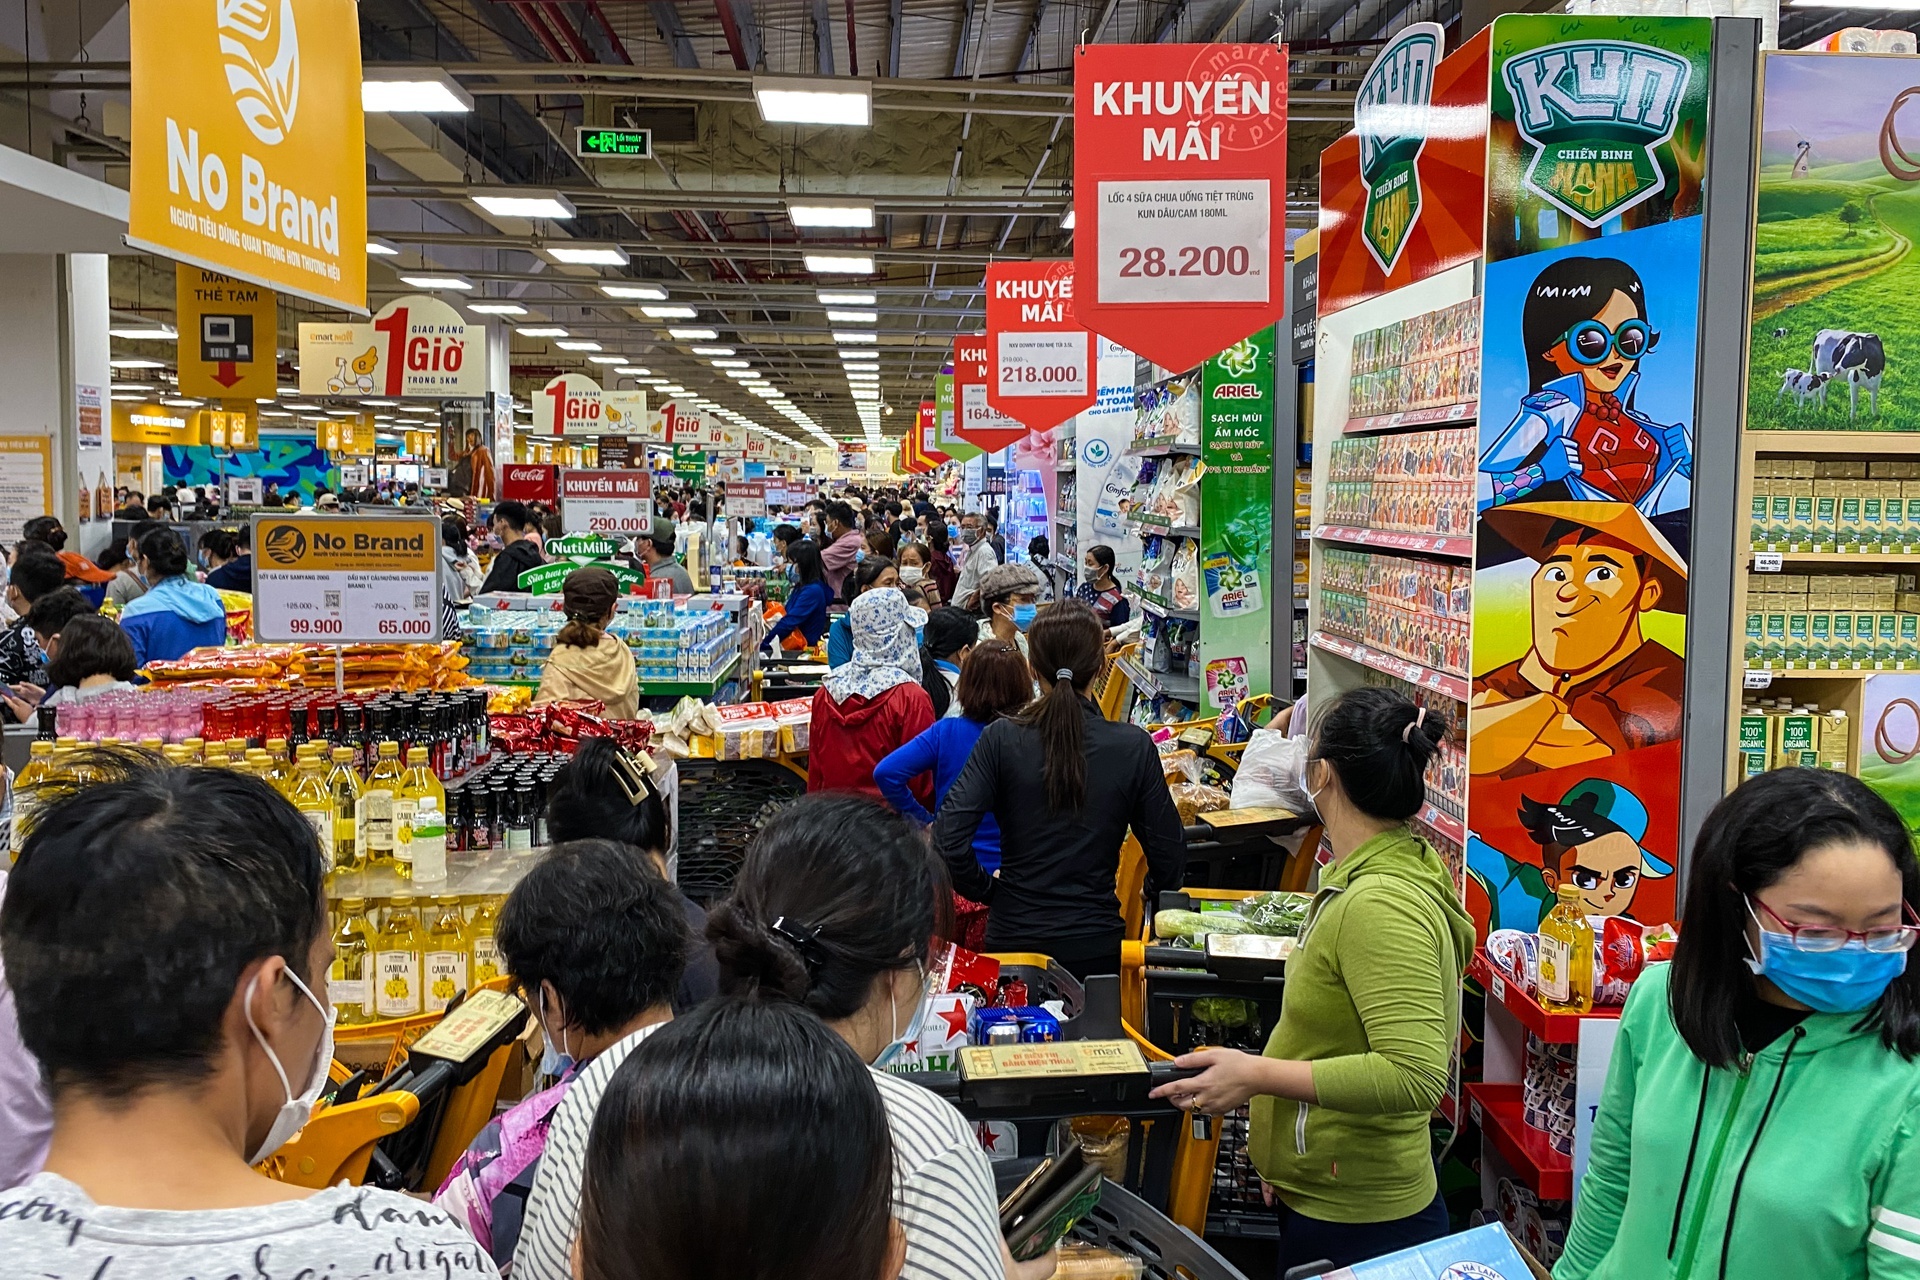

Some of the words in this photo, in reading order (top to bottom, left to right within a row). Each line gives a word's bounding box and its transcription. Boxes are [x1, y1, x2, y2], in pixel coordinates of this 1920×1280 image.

[1199, 45, 1270, 83] emart
[1513, 46, 1686, 126] KUN
[1093, 72, 1270, 116] KHUYẾN
[1143, 120, 1220, 161] MÃI
[619, 145, 640, 153] EXIT
[1600, 149, 1634, 160] BINH
[166, 117, 229, 212] No
[241, 153, 340, 257] Brand
[1108, 189, 1126, 203] LỐC
[1126, 193, 1132, 203] 4
[1134, 190, 1153, 203] SỮA
[1154, 193, 1178, 202] CHUA
[1179, 188, 1203, 202] UỐNG
[1205, 191, 1224, 204] TIỆT
[1225, 189, 1254, 202] TRÙNG
[1137, 209, 1155, 219] KUN
[1157, 207, 1198, 219] DÂU/CAM
[1200, 208, 1228, 218] 180ML
[170, 205, 198, 233] NGƯỜI
[241, 232, 262, 255] QUAN
[262, 240, 286, 264] TRỌNG
[1119, 246, 1250, 278] 28.200
[995, 275, 1074, 299] KHUYẾ
[227, 290, 259, 306] TẠM
[1021, 301, 1063, 322] MÃI
[412, 325, 434, 334] GIAO
[438, 323, 464, 334] HÀNG
[374, 307, 409, 397] 1
[407, 337, 464, 372] Giờ
[408, 376, 436, 385] TRONG
[440, 376, 458, 385] 5KM
[1002, 366, 1077, 382] 218.000
[1213, 384, 1262, 399] ARIEL
[545, 381, 567, 435] 1
[566, 398, 601, 419] Giờ
[660, 404, 676, 443] 1
[1211, 414, 1239, 425] SẠCH
[1242, 412, 1263, 422] MÙI
[1234, 426, 1259, 437] MỐC
[1209, 441, 1233, 451] SẠCH
[566, 477, 613, 492] KHUYẾN
[616, 478, 639, 492] MÃI
[589, 517, 648, 531] 290.000
[313, 533, 346, 550] No
[354, 533, 423, 550] Brand
[552, 541, 613, 554] NutiMilk
[1221, 591, 1248, 602] ARIEL
[290, 619, 342, 633] 99.900
[379, 620, 431, 634] 65.000
[1218, 688, 1239, 697] ARIEL
[1784, 740, 1809, 748] ORGANIC
[475, 950, 499, 959] CANOLA
[384, 964, 409, 974] CANOLA
[432, 965, 456, 975] CANOLA
[1083, 1046, 1124, 1056] emart
[1478, 1265, 1496, 1279] LAN
